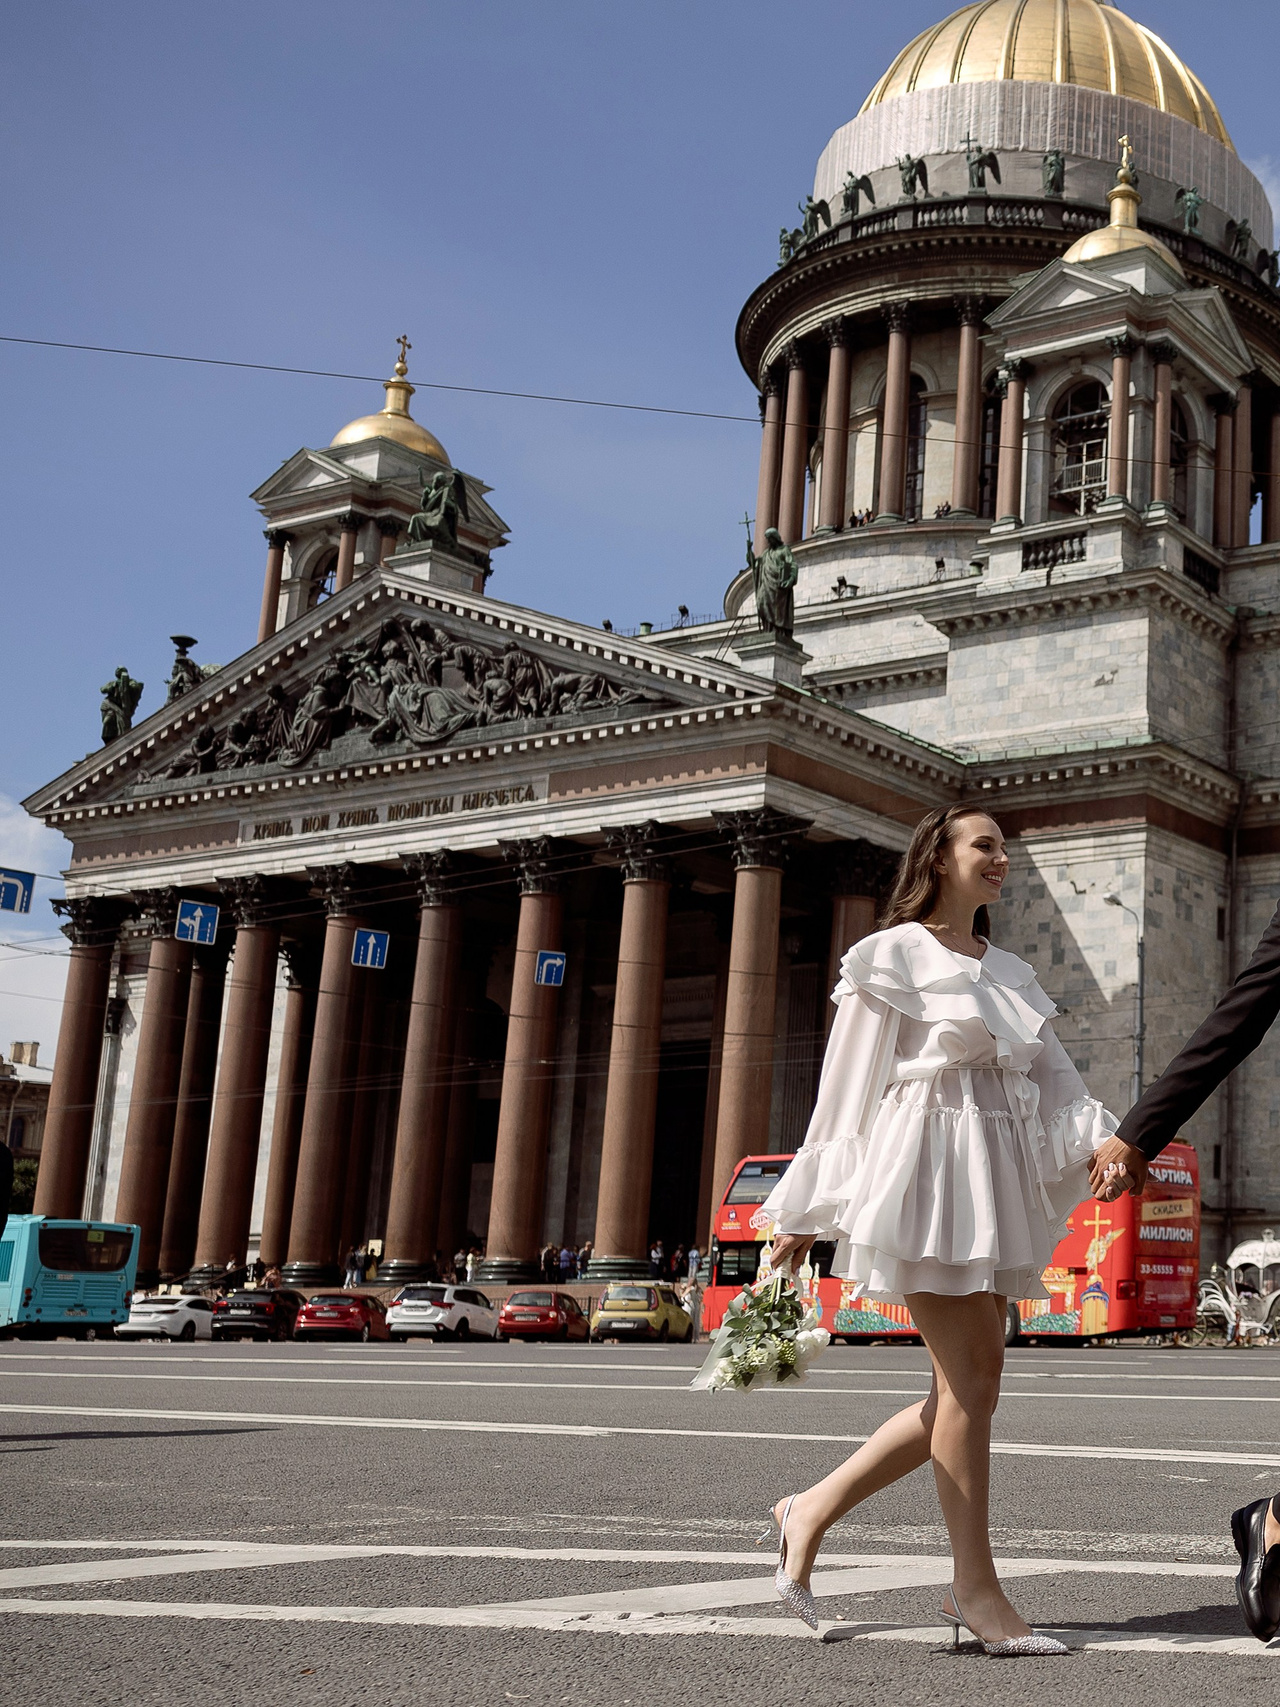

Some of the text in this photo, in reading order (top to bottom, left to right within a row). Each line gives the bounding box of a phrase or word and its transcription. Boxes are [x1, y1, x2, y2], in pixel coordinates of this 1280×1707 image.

[1153, 1204, 1183, 1216] СКИДКА
[1139, 1225, 1194, 1242] МИЛЛИОН
[1140, 1264, 1174, 1275] 33-55555
